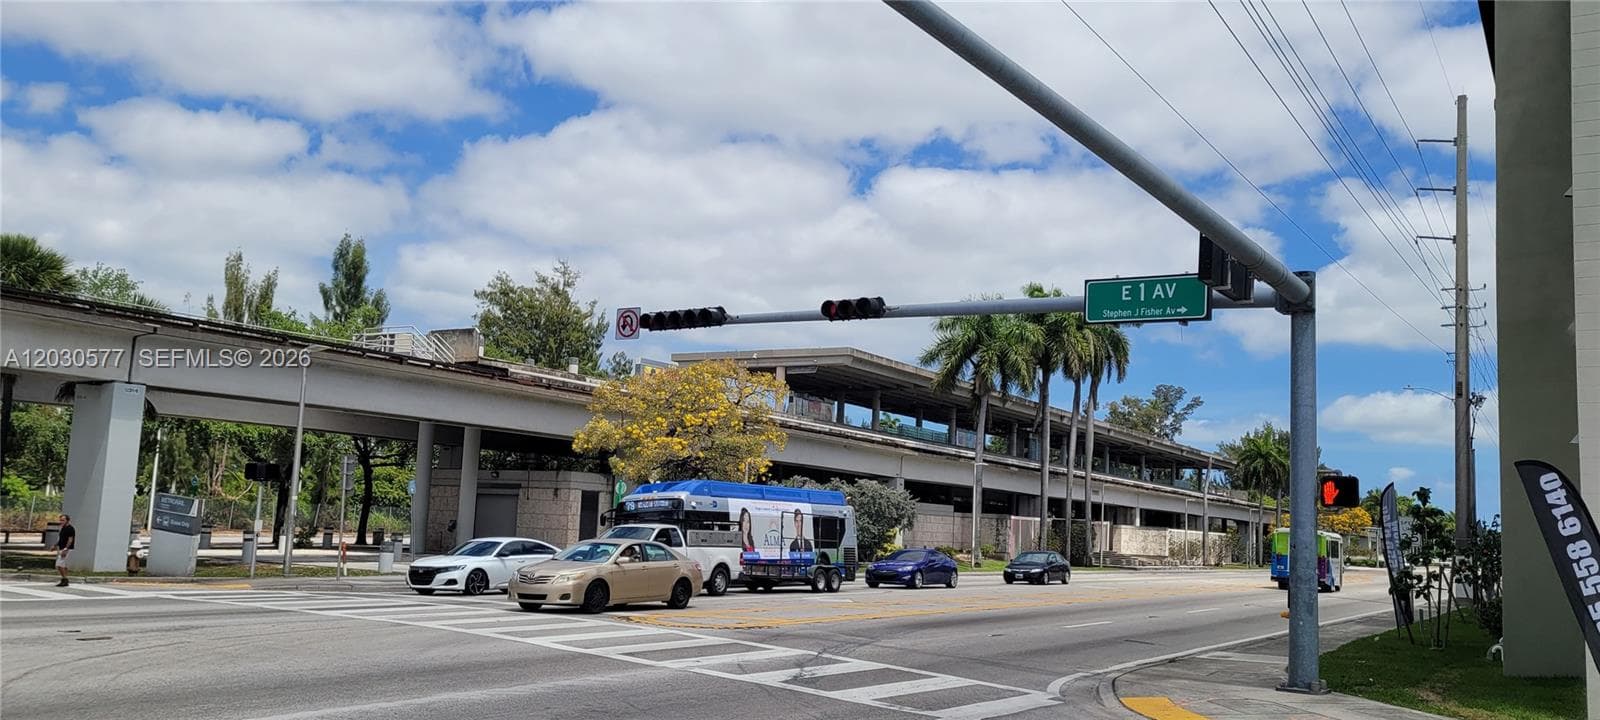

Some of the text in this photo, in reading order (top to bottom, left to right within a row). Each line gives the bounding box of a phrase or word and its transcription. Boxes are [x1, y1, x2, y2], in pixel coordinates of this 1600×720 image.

[1122, 282, 1177, 301] E 1 AV
[1102, 306, 1176, 318] Stephen J Fisher Av
[1539, 472, 1582, 537] 6140
[1566, 539, 1600, 597] 558
